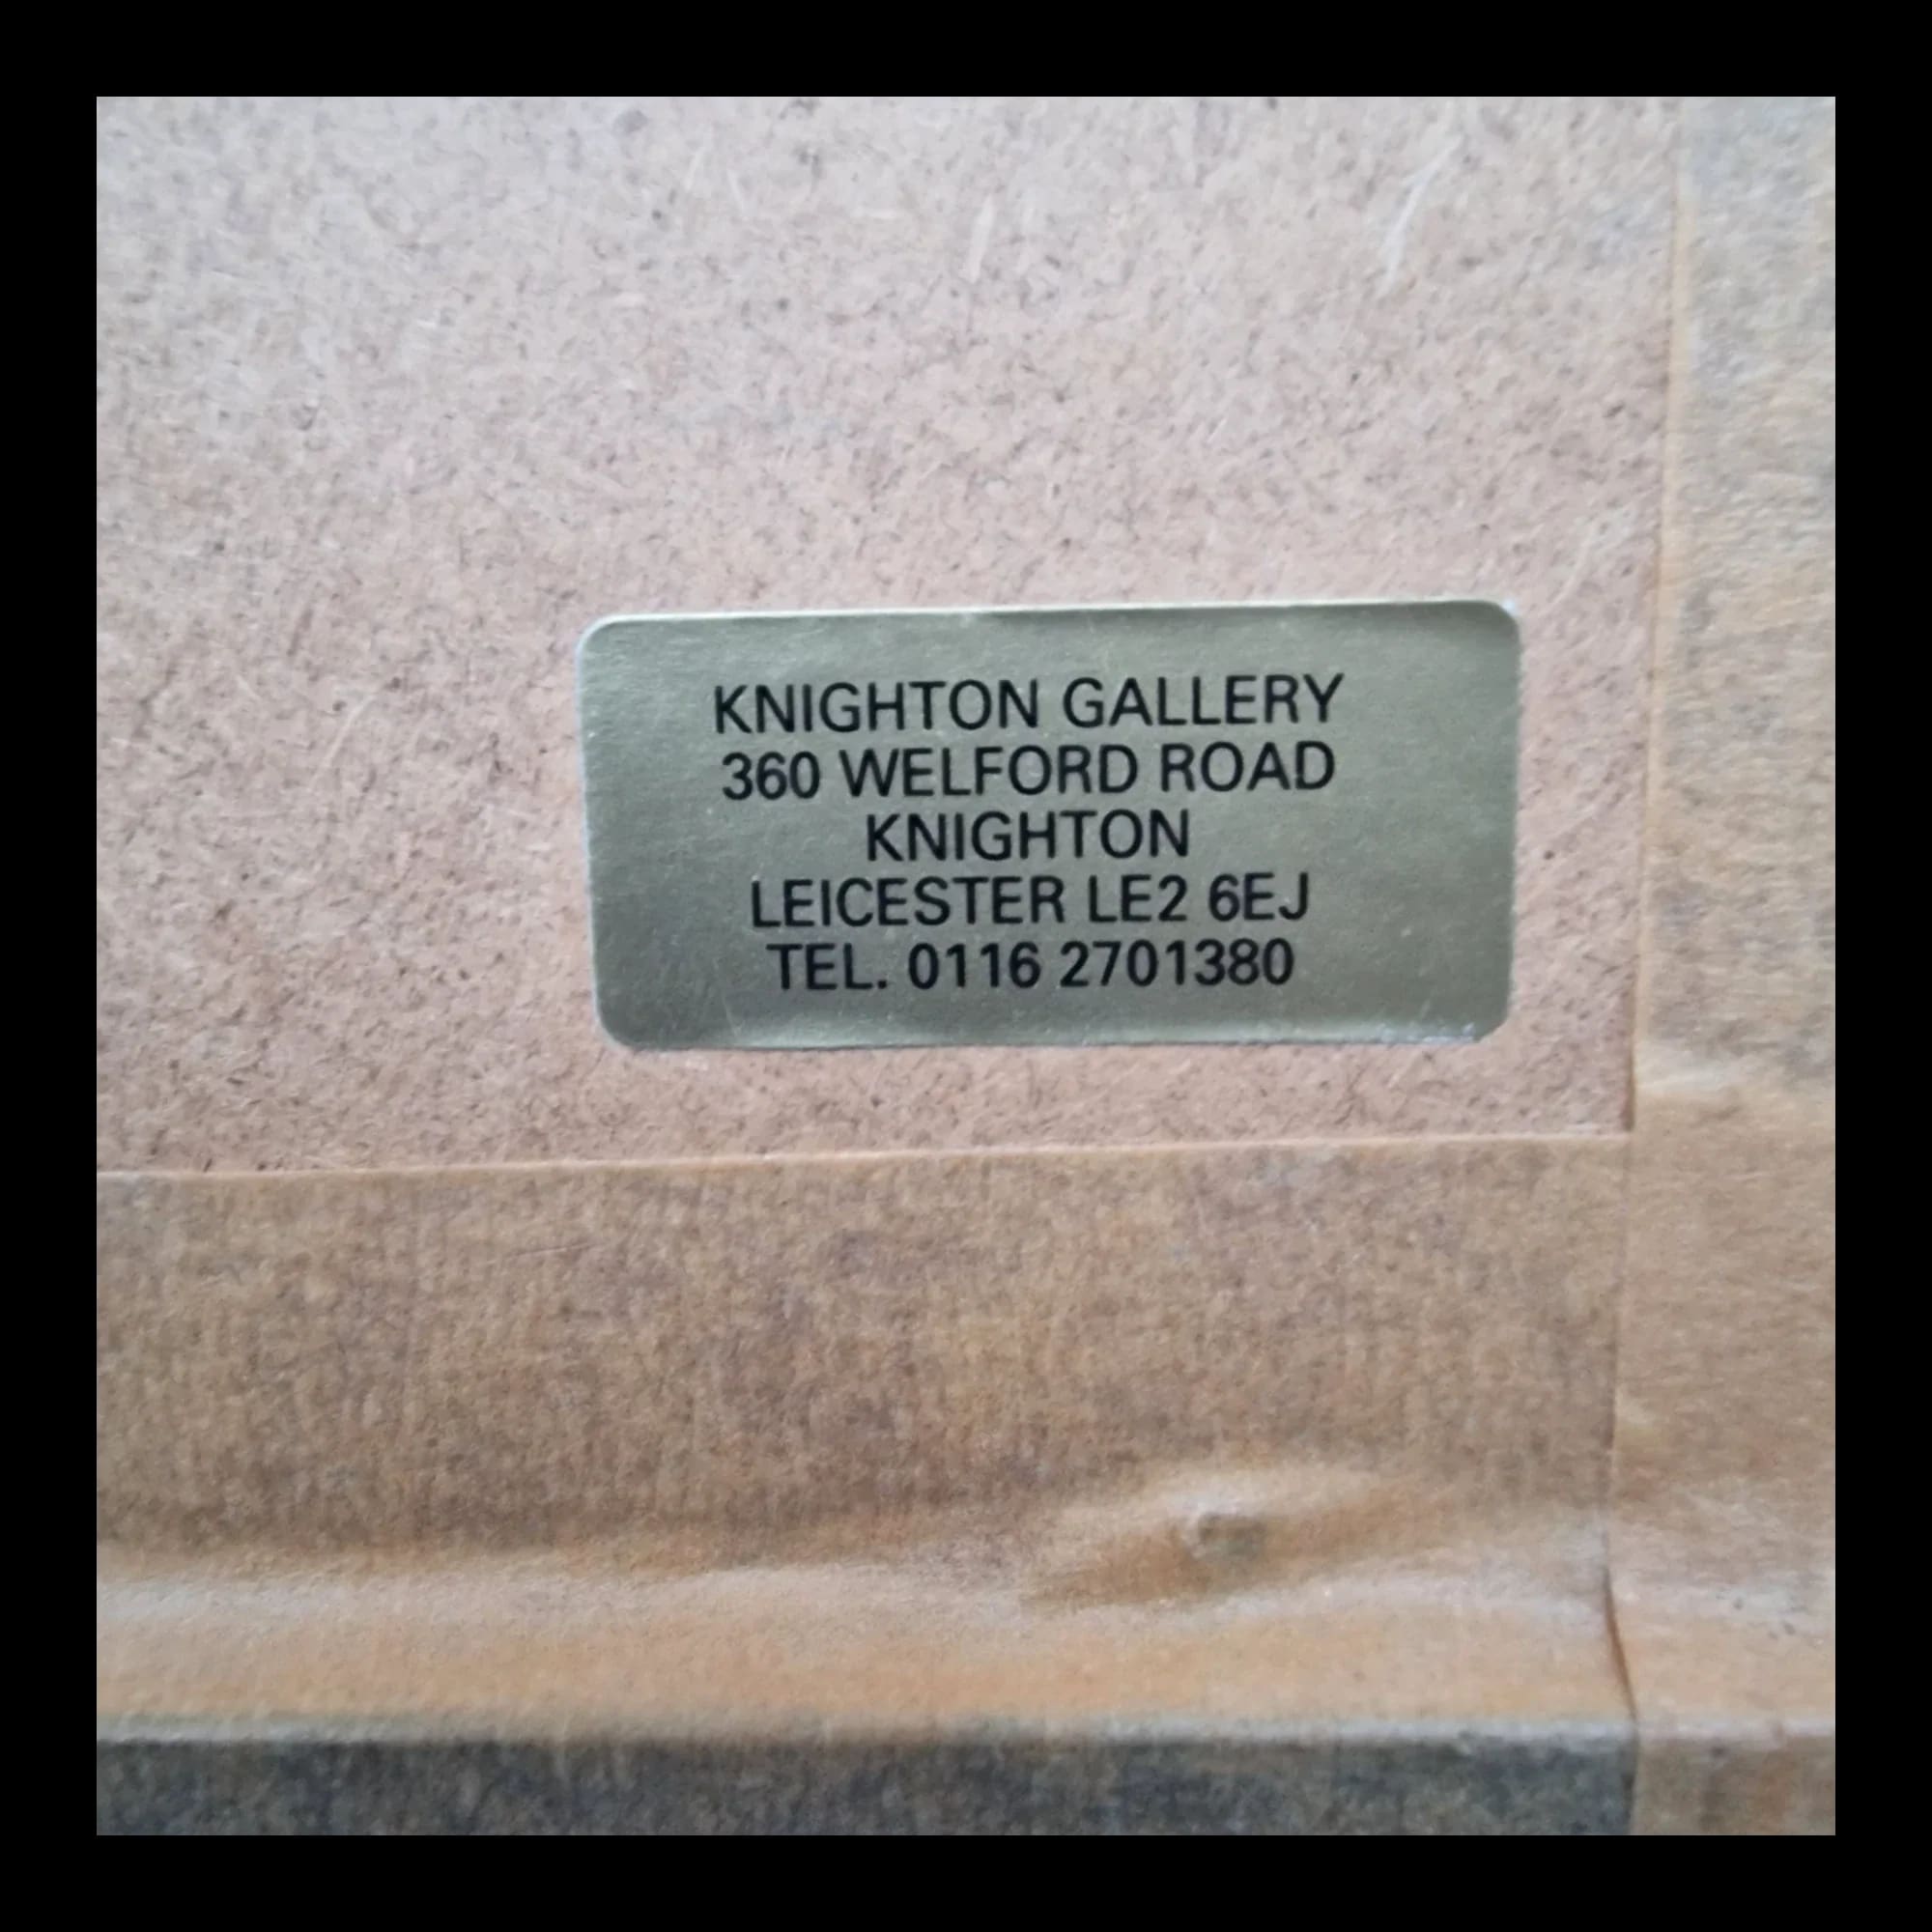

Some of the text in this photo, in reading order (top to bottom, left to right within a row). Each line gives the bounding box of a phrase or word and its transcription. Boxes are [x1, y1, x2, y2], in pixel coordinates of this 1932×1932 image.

[714, 672, 1345, 735] KNIGHTON GALLERY
[722, 740, 1336, 802] 360 WELFORD ROAD
[867, 809, 1189, 864] KNIGHTON
[751, 871, 1310, 928] LEICESTER LE2 6EJ
[765, 937, 1295, 991] TEL. 0116 2701380
